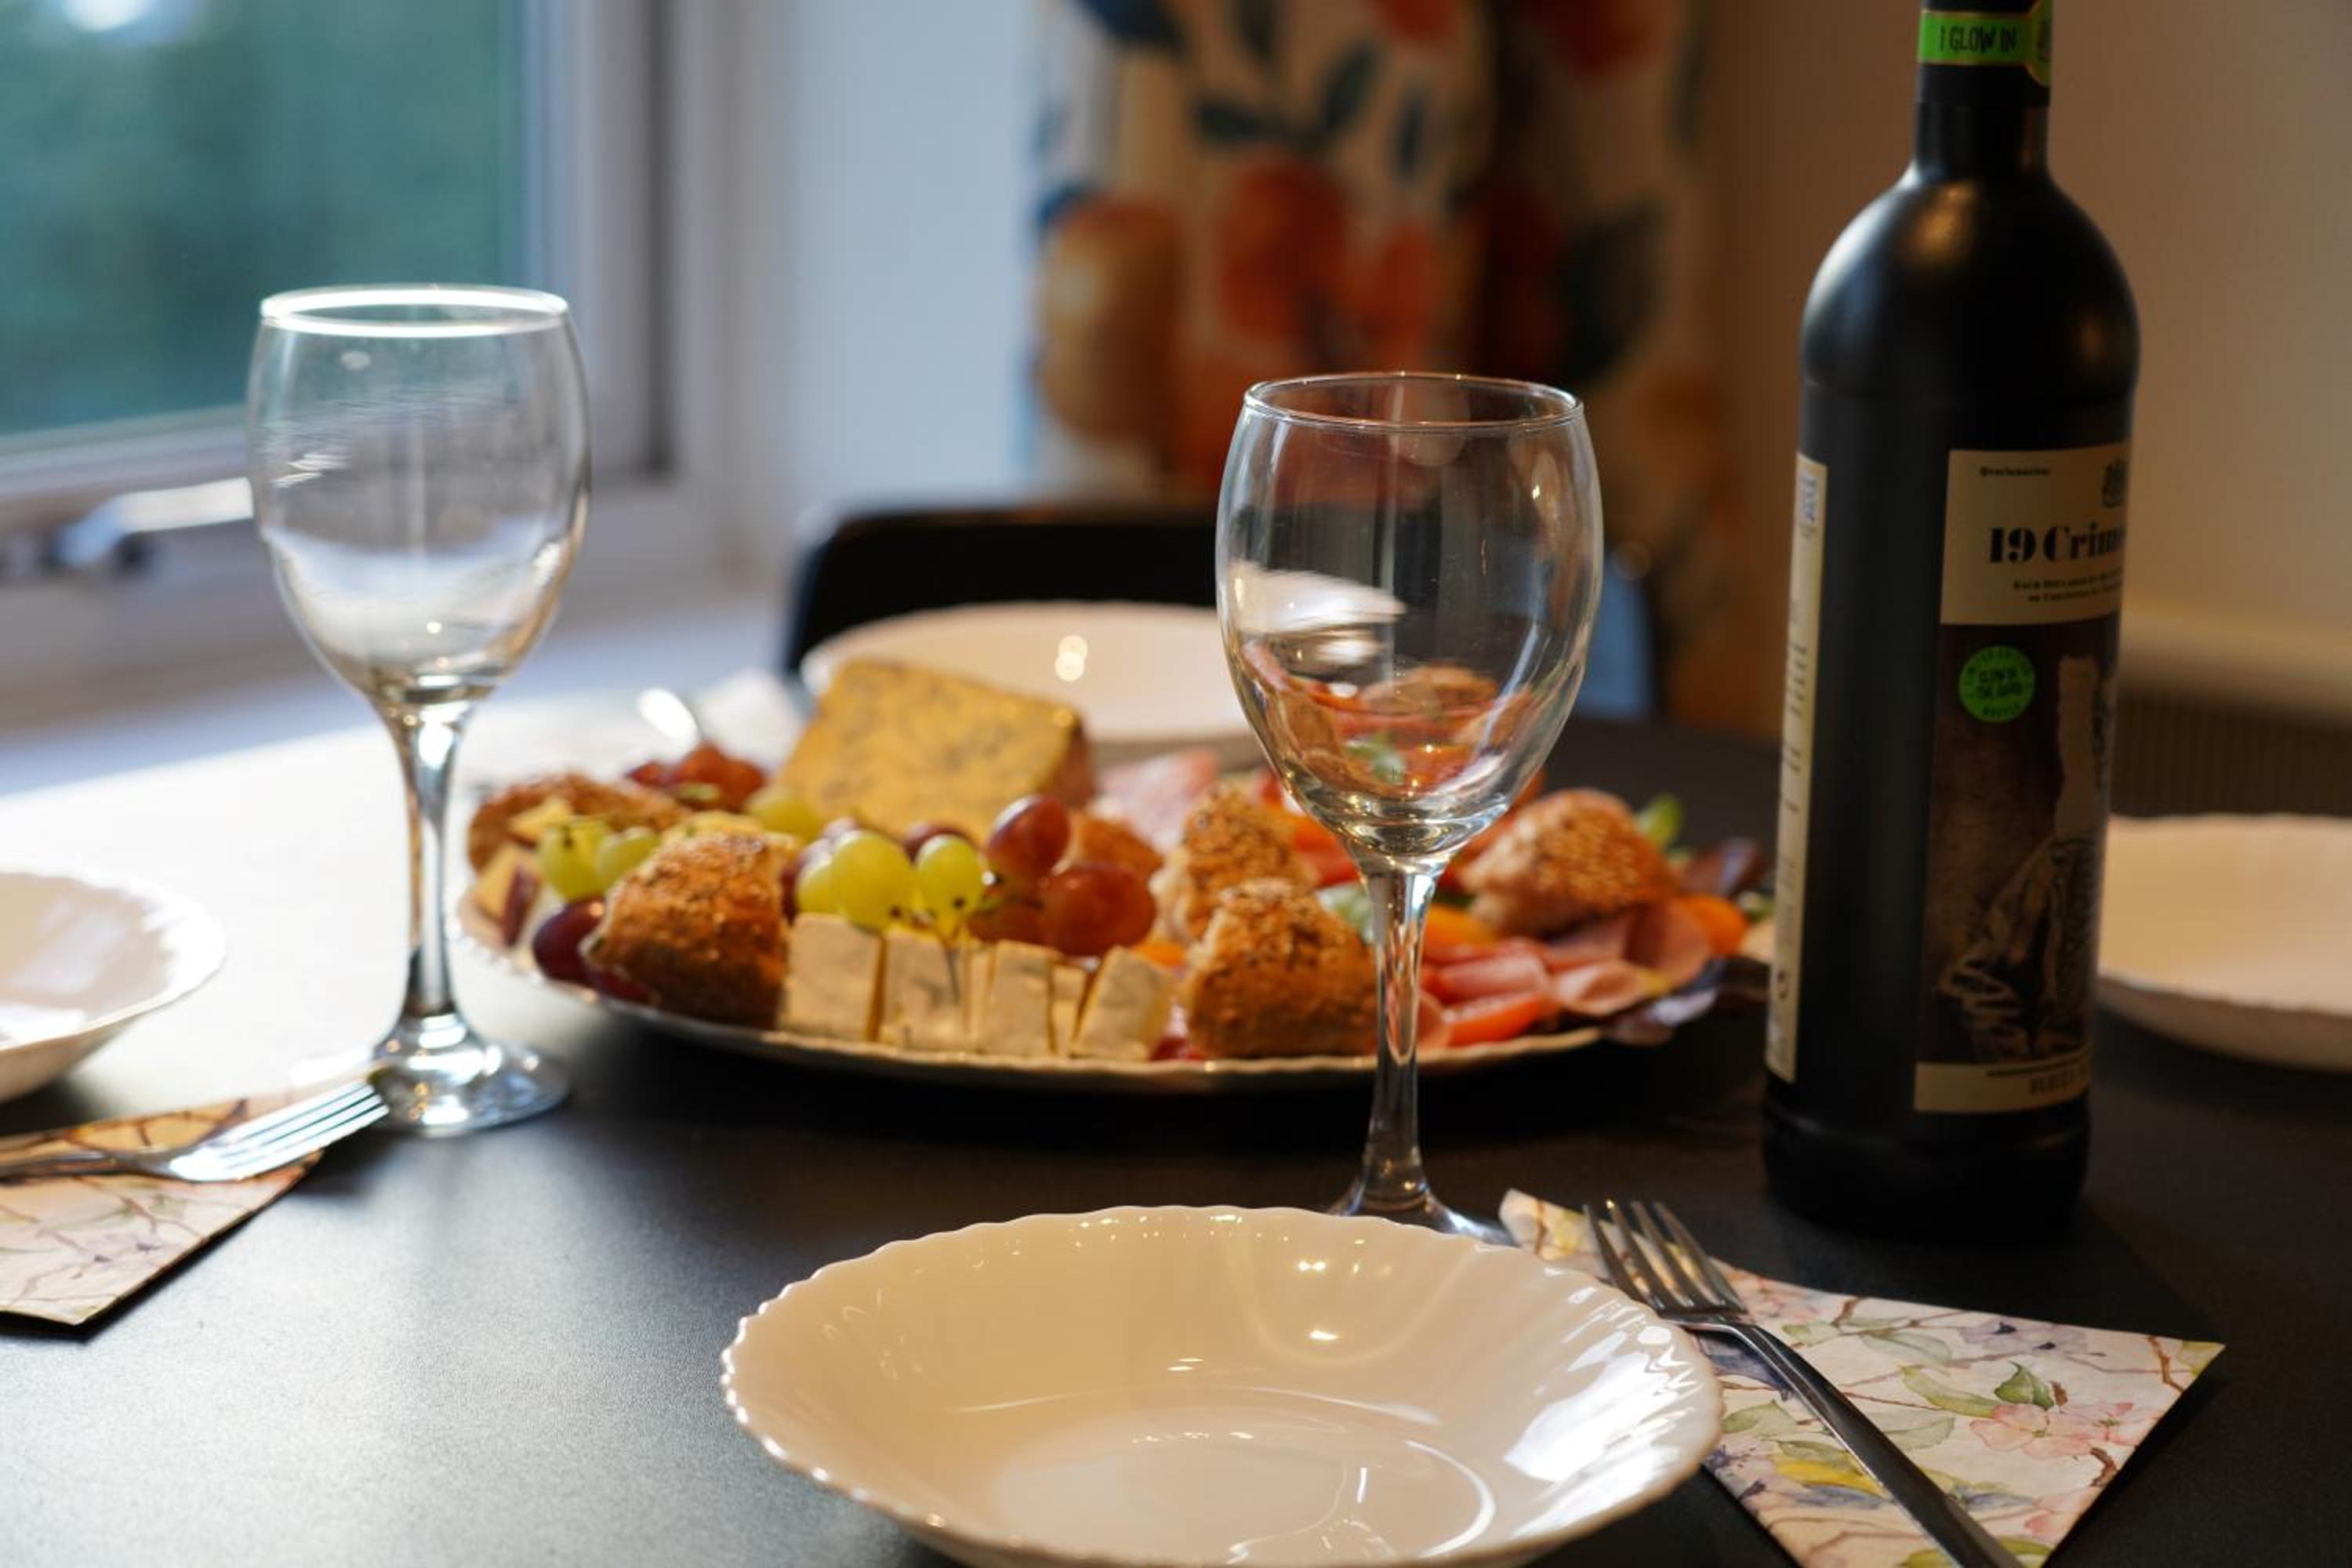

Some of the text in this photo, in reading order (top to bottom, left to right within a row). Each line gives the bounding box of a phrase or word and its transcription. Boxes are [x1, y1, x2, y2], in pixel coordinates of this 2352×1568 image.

[1940, 26, 1945, 51] I
[1949, 27, 1995, 53] GLOW
[2000, 27, 2018, 53] IN
[1988, 527, 2036, 563] 19
